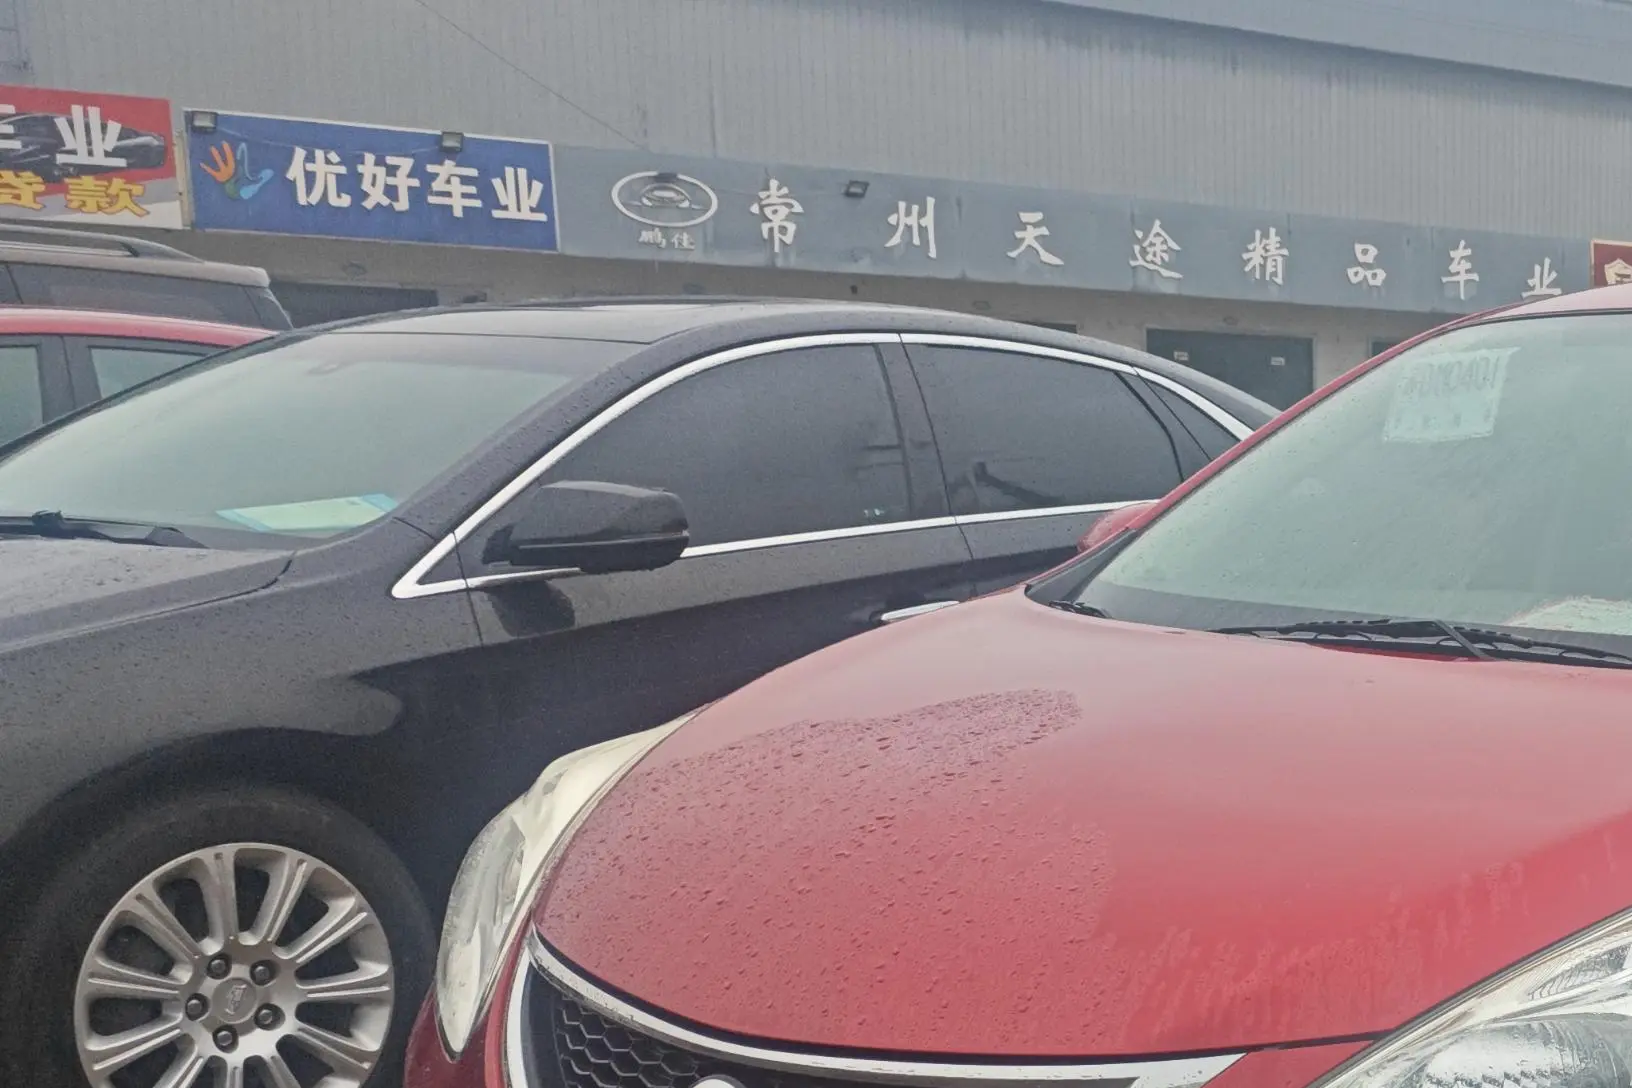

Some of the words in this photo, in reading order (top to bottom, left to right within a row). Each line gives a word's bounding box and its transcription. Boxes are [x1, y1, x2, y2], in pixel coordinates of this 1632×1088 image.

[286, 146, 548, 223] 优好车业
[749, 178, 1563, 300] 常州天途精品车业
